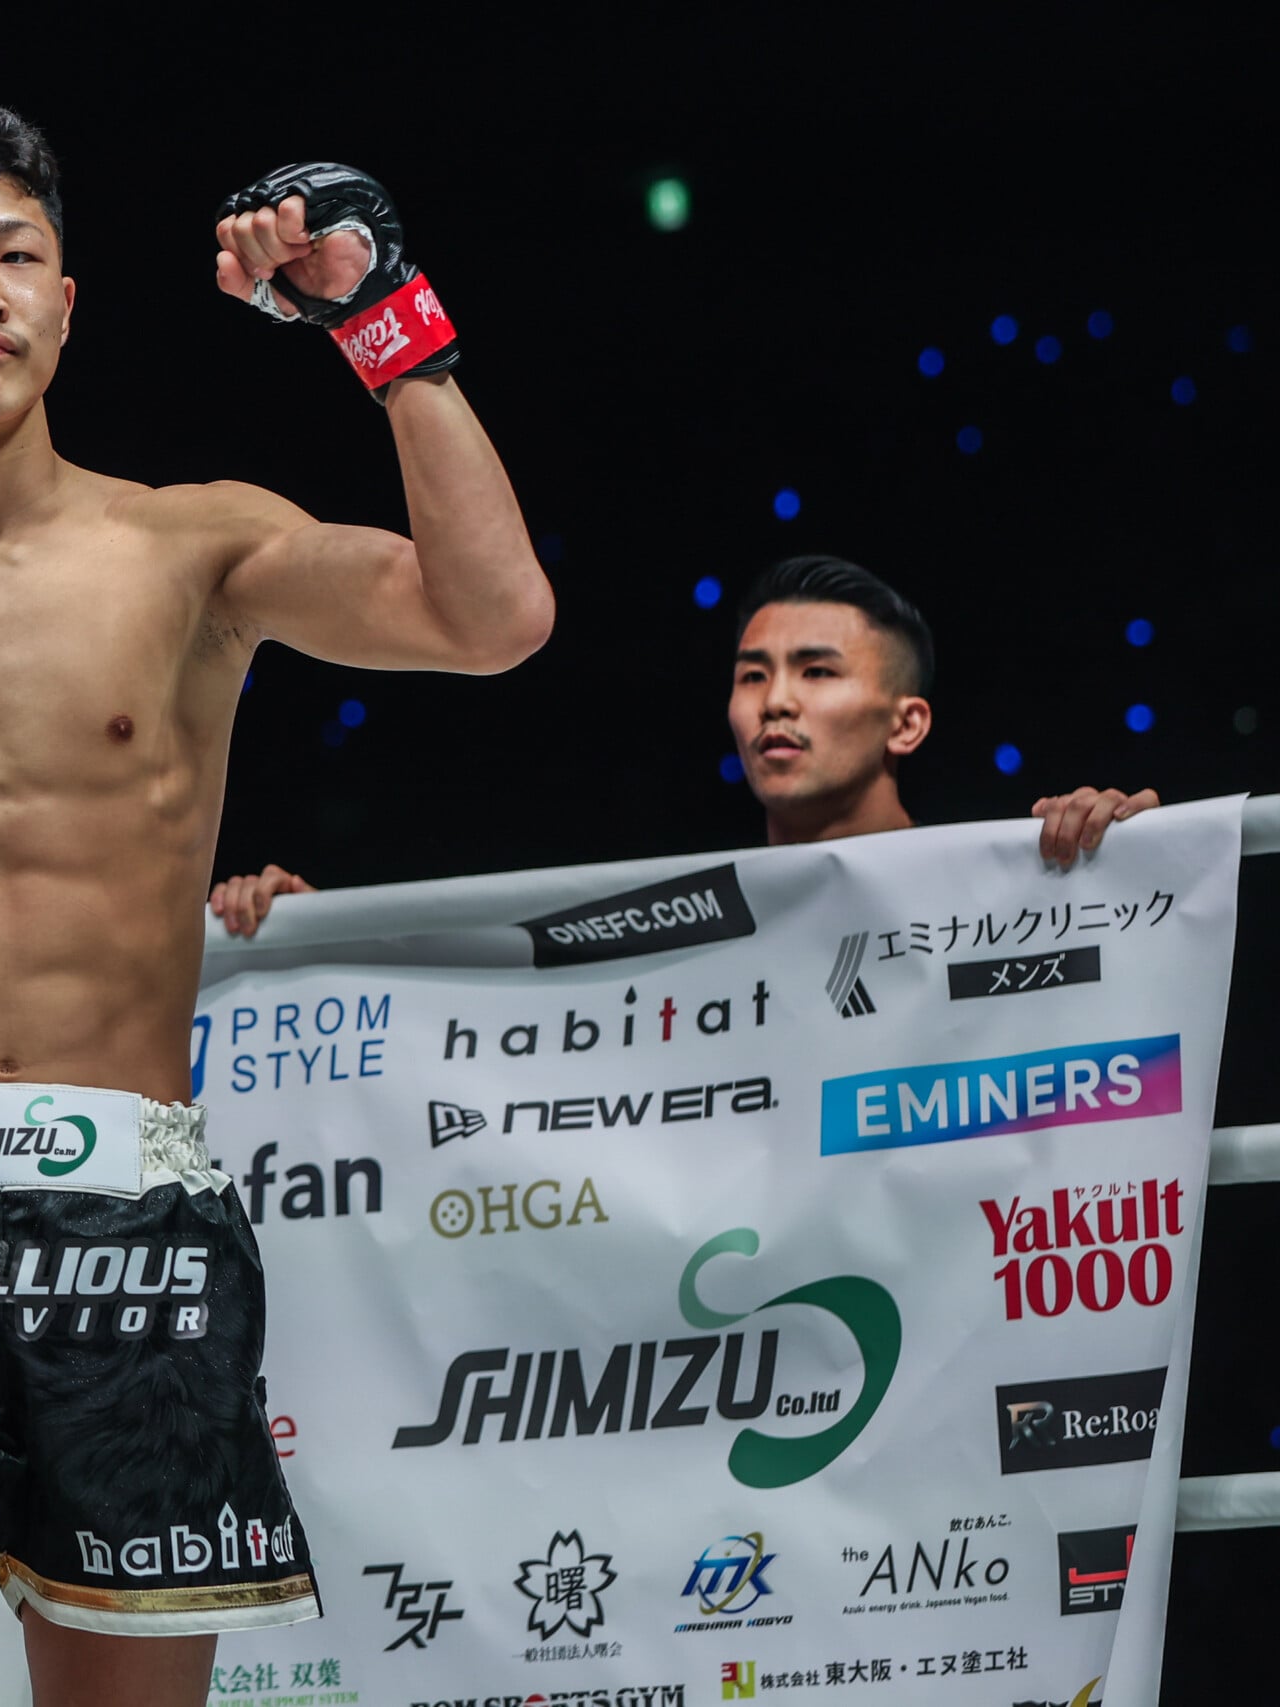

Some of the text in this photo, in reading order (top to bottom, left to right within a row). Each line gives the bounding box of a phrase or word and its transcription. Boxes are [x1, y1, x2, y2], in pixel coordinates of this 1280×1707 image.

[547, 888, 724, 946] ONEFC.COM
[877, 889, 1176, 962] エミナルクリニック
[987, 952, 1067, 993] メンズ
[231, 993, 391, 1046] PROM
[442, 979, 770, 1060] habitat
[230, 1038, 385, 1093] STYLE
[856, 1053, 1142, 1138] EMINERS
[978, 1177, 1185, 1257] Yakult
[1073, 1181, 1137, 1200] ヤクルト
[993, 1243, 1173, 1321] 1000
[390, 1329, 841, 1450] SHIMIZU Co.ltd
[76, 1502, 295, 1576] habitat
[841, 1537, 1010, 1597] the ANko
[545, 1565, 587, 1611] 曙
